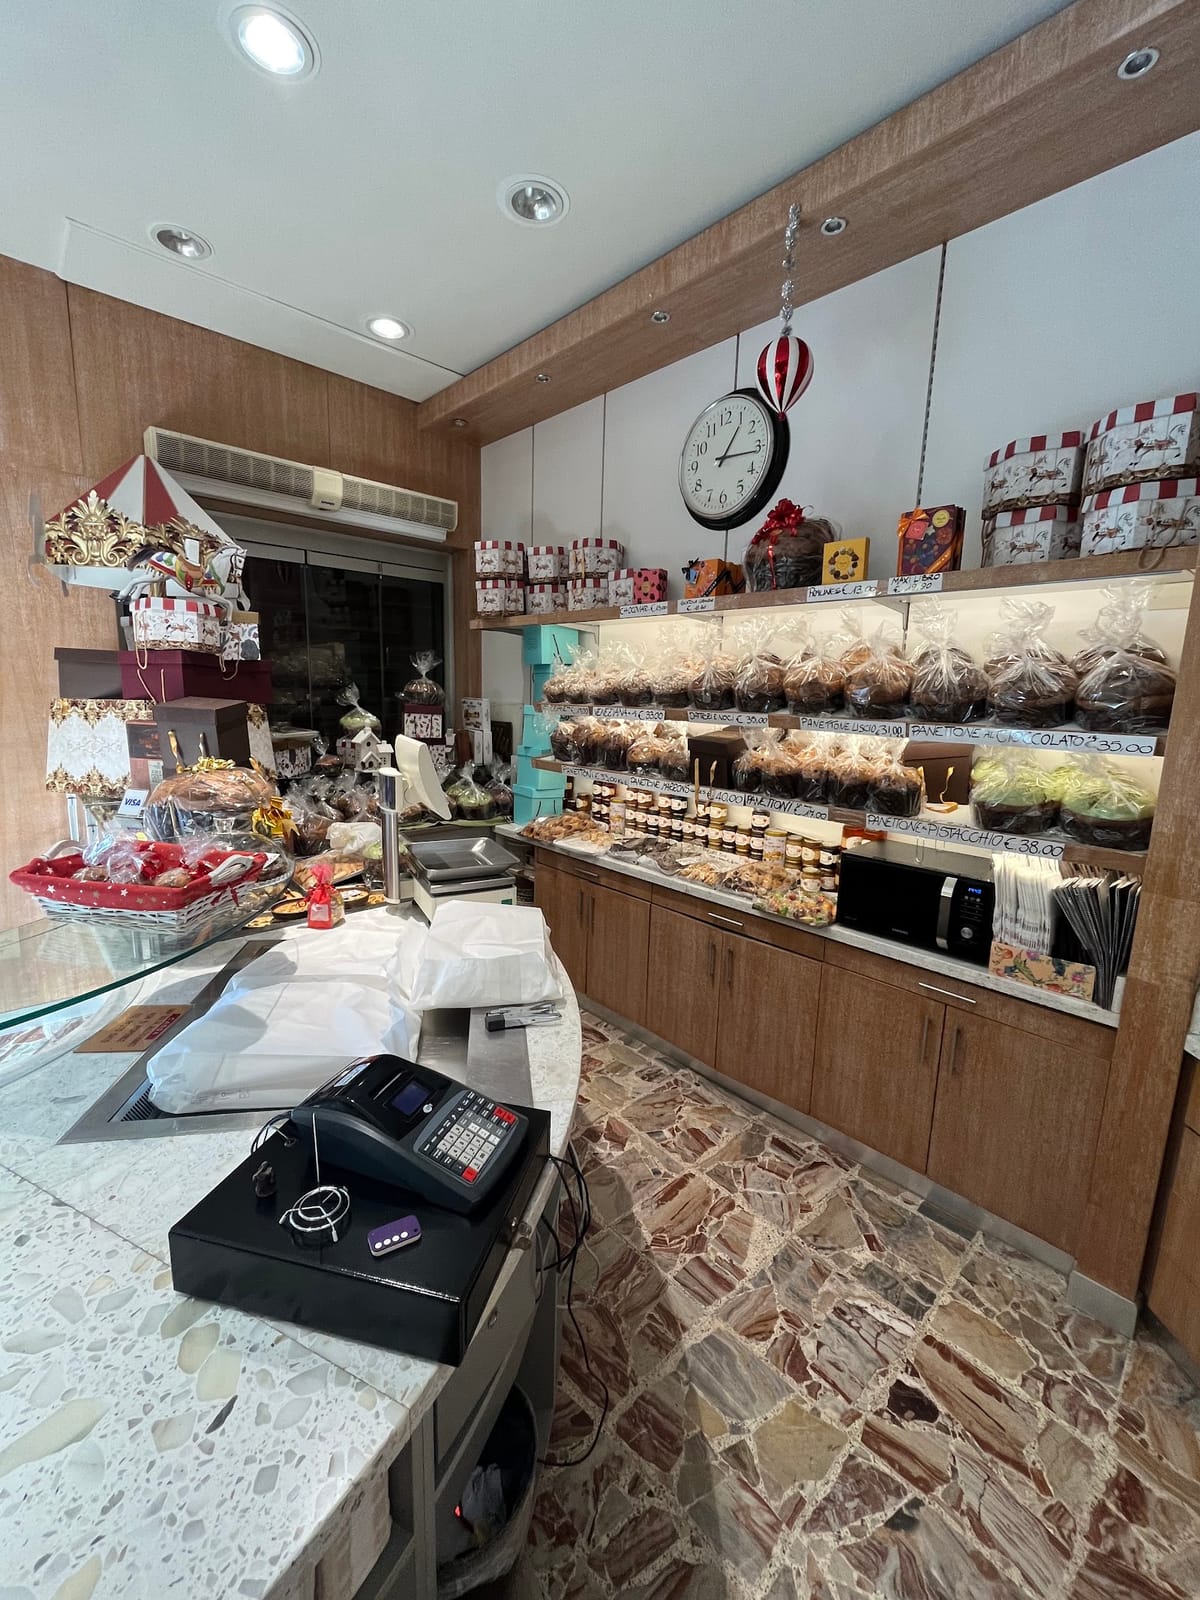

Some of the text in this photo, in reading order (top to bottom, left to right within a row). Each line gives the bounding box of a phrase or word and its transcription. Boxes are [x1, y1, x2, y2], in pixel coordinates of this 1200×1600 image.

[720, 411, 732, 426] 12
[706, 423, 716, 438] 11
[748, 420, 756, 435] 2
[696, 442, 708, 456] 10
[755, 439, 761, 454] 3
[690, 461, 699, 474] 9
[747, 461, 756, 475] 4
[694, 479, 702, 492] 8
[736, 480, 744, 494] 5
[706, 489, 714, 502] 7
[719, 490, 728, 504] 6
[801, 717, 850, 730] PANETTONE
[911, 725, 981, 738] PANETTONE
[996, 730, 1085, 746] CIOCCOLATO
[867, 814, 921, 834] PANETTONE
[928, 823, 1004, 846] PISTACCHIO
